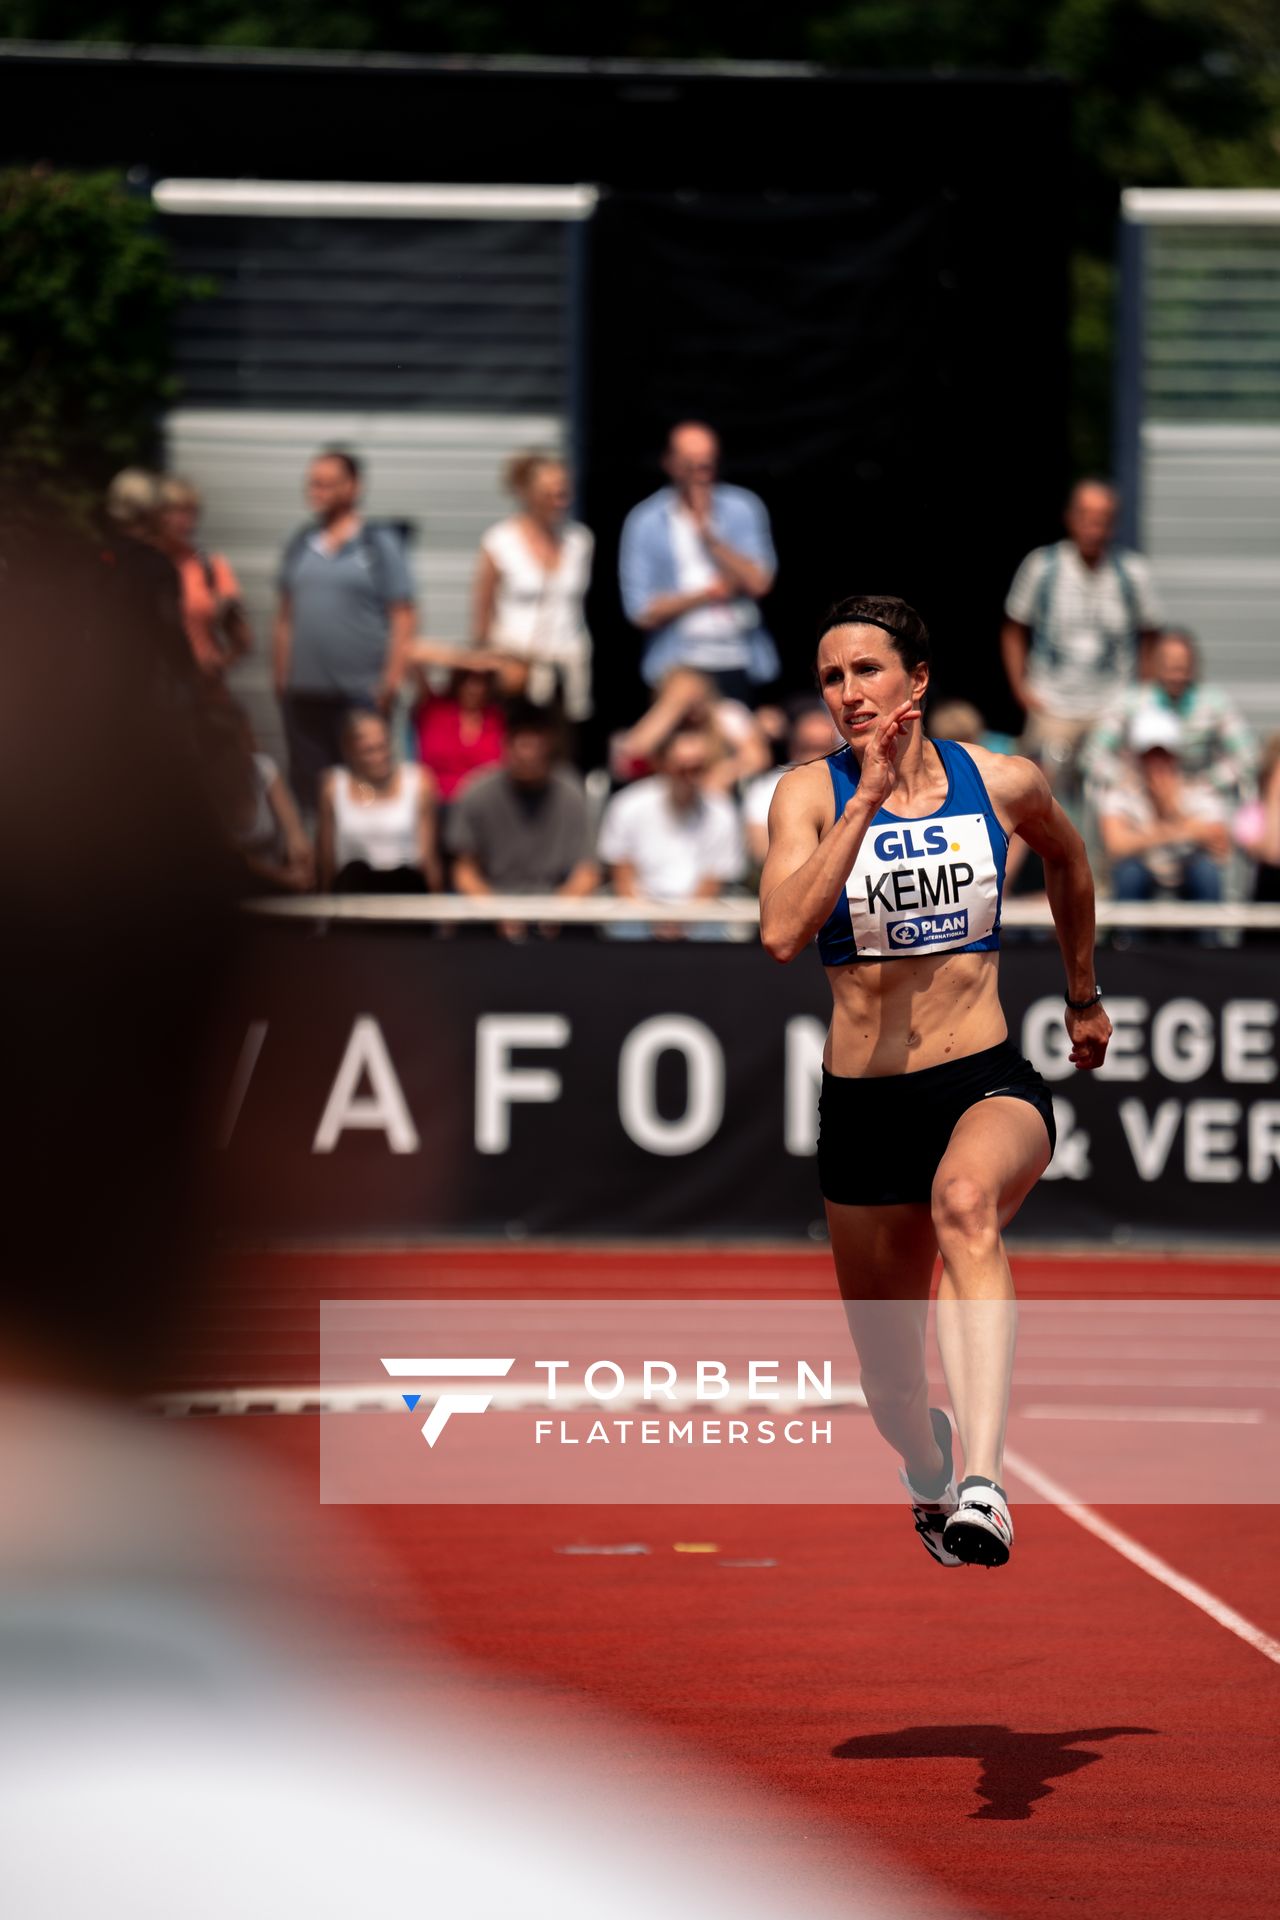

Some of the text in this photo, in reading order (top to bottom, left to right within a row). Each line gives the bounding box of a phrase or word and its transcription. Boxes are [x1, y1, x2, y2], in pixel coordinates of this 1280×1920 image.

[865, 862, 974, 914] KEMP
[921, 916, 965, 934] PLAN
[923, 931, 965, 941] INTERNATIONAL
